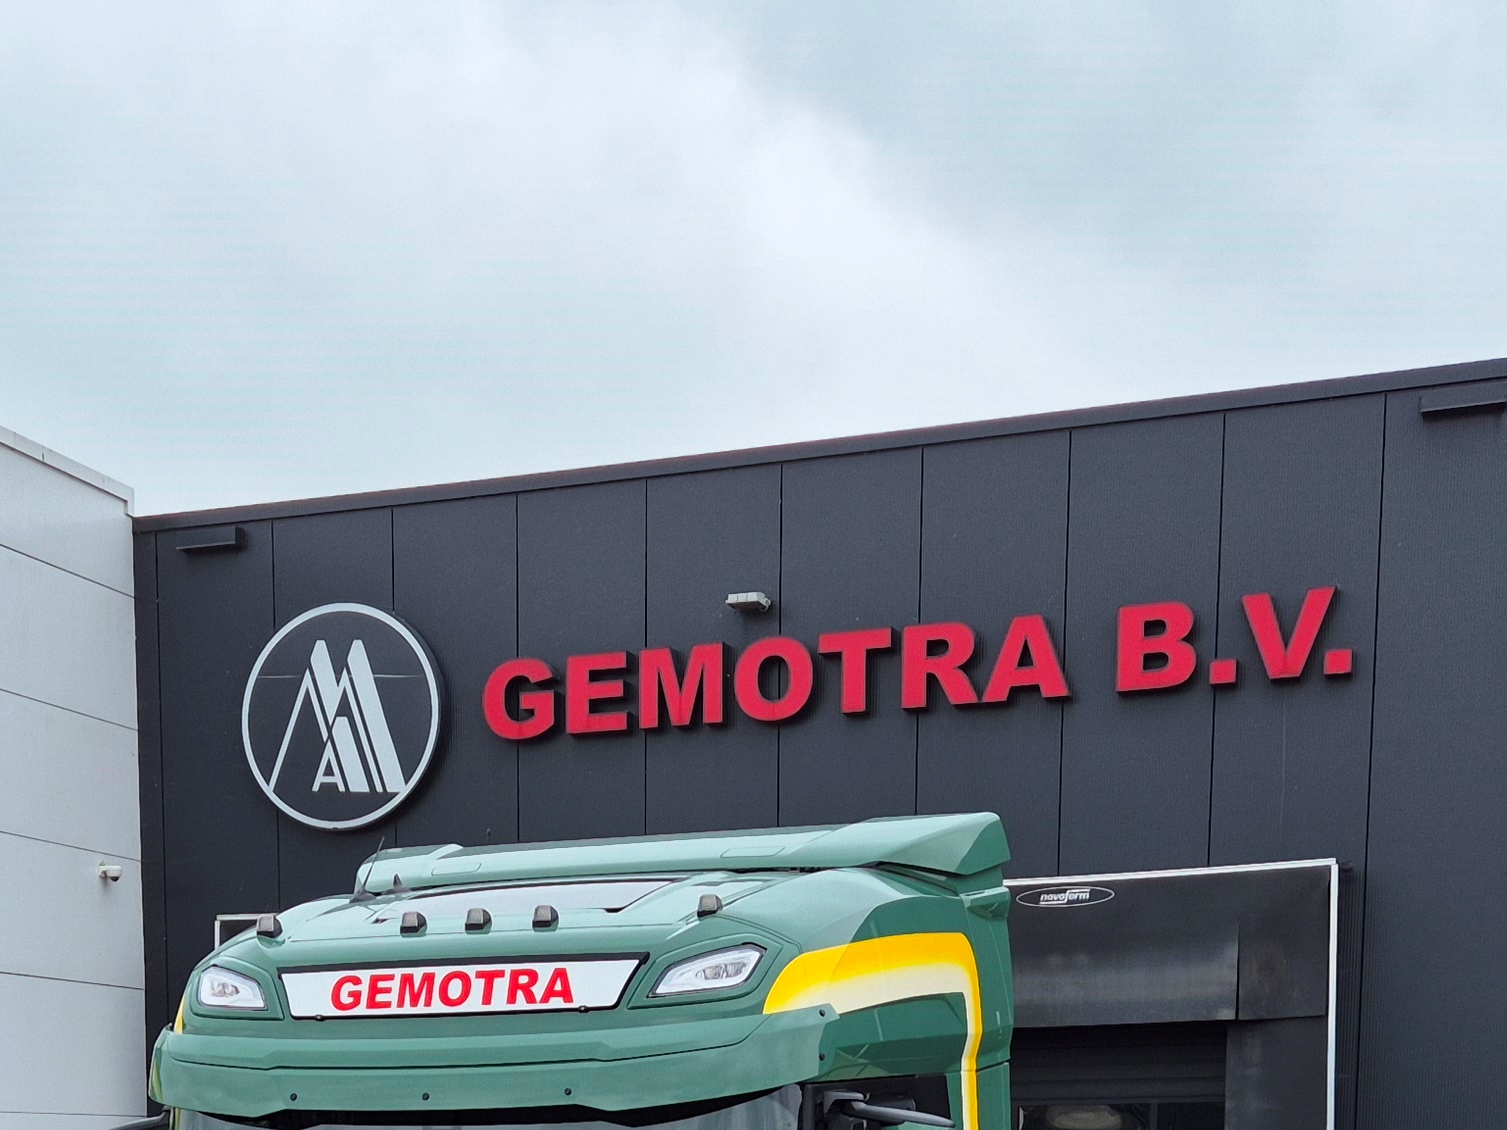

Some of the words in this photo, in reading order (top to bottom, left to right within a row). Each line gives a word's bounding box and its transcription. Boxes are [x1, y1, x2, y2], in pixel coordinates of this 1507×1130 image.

[481, 614, 1071, 741] GEMOTRA
[1115, 585, 1354, 694] B.V.
[1039, 889, 1091, 904] novoferm
[330, 966, 575, 1012] GEMOTRA
